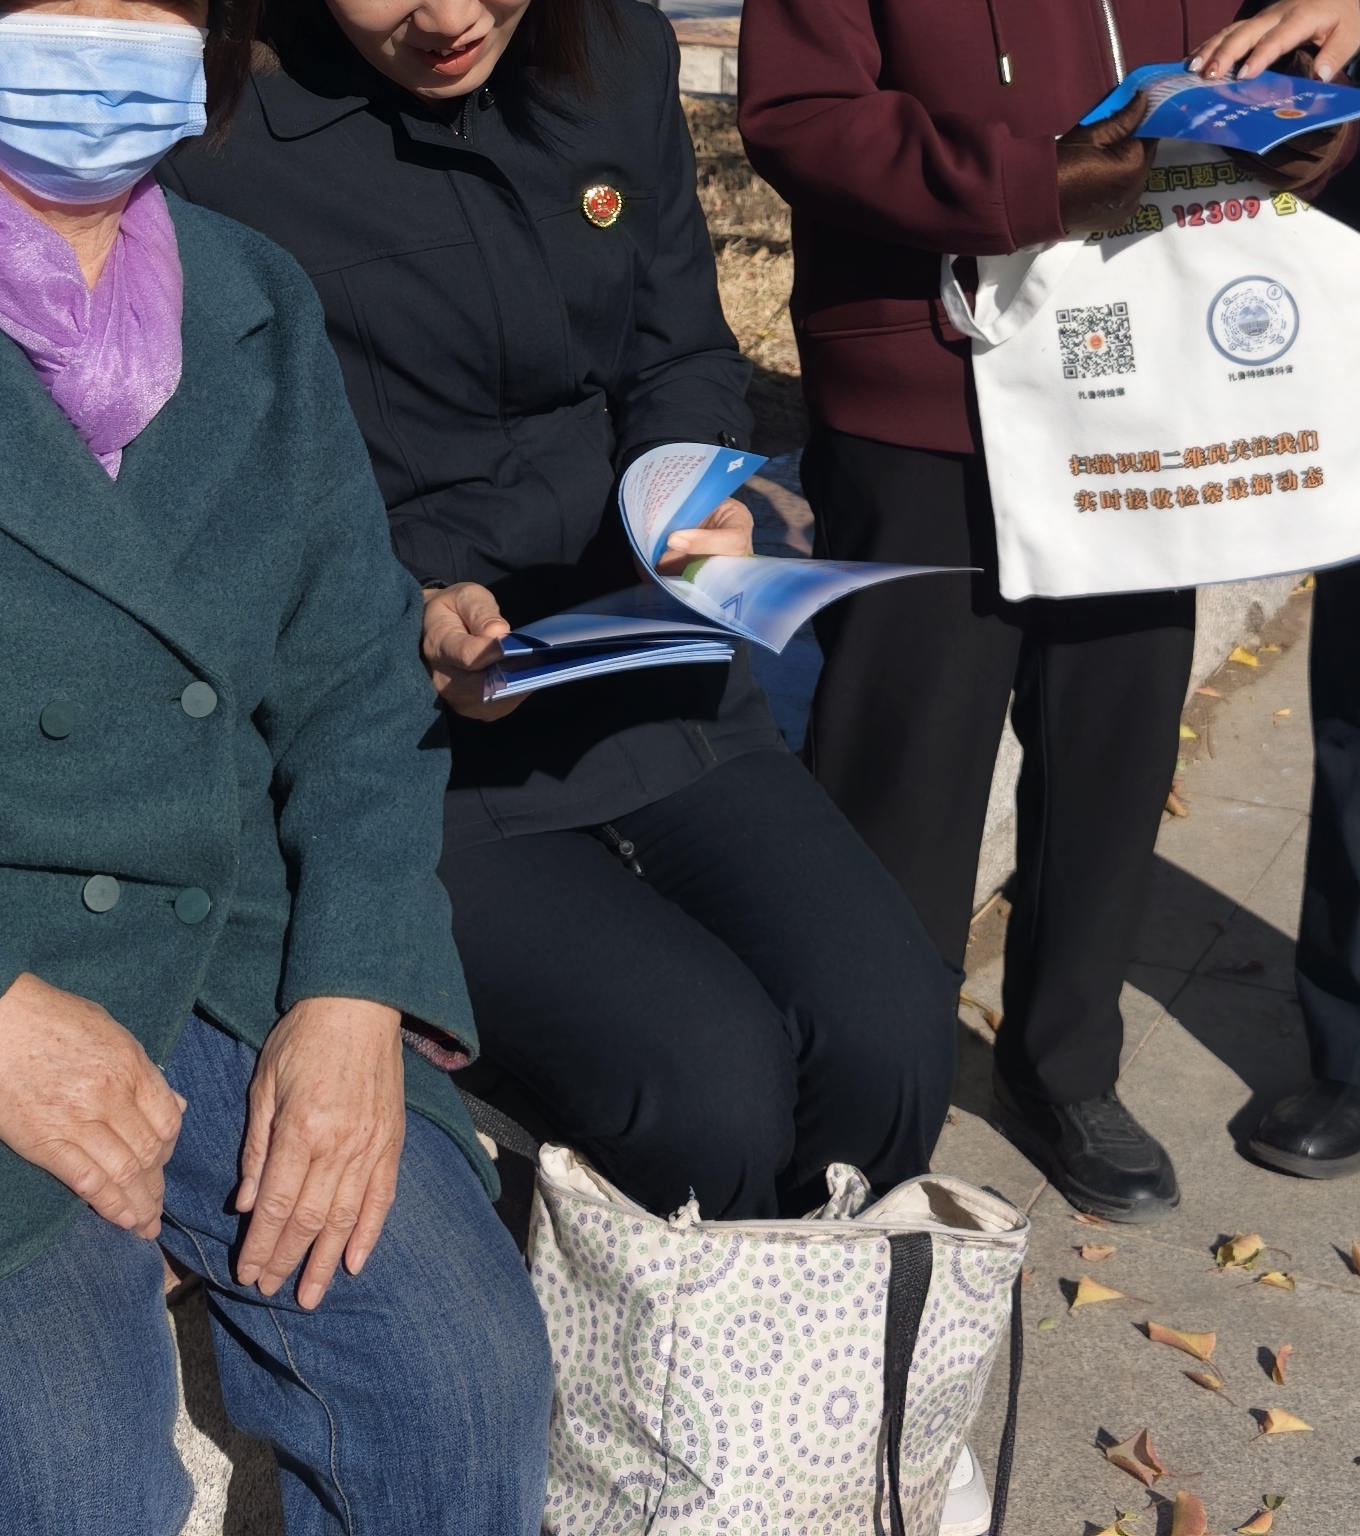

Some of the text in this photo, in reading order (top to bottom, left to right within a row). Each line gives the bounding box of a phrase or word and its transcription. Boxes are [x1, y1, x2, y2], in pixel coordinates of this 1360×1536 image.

[1142, 160, 1254, 193] 督问题可
[1171, 195, 1261, 228] 12309
[1068, 429, 1320, 477] 扫描识别二维码关注我们
[1072, 466, 1325, 513] 实时接收检察最新动态
